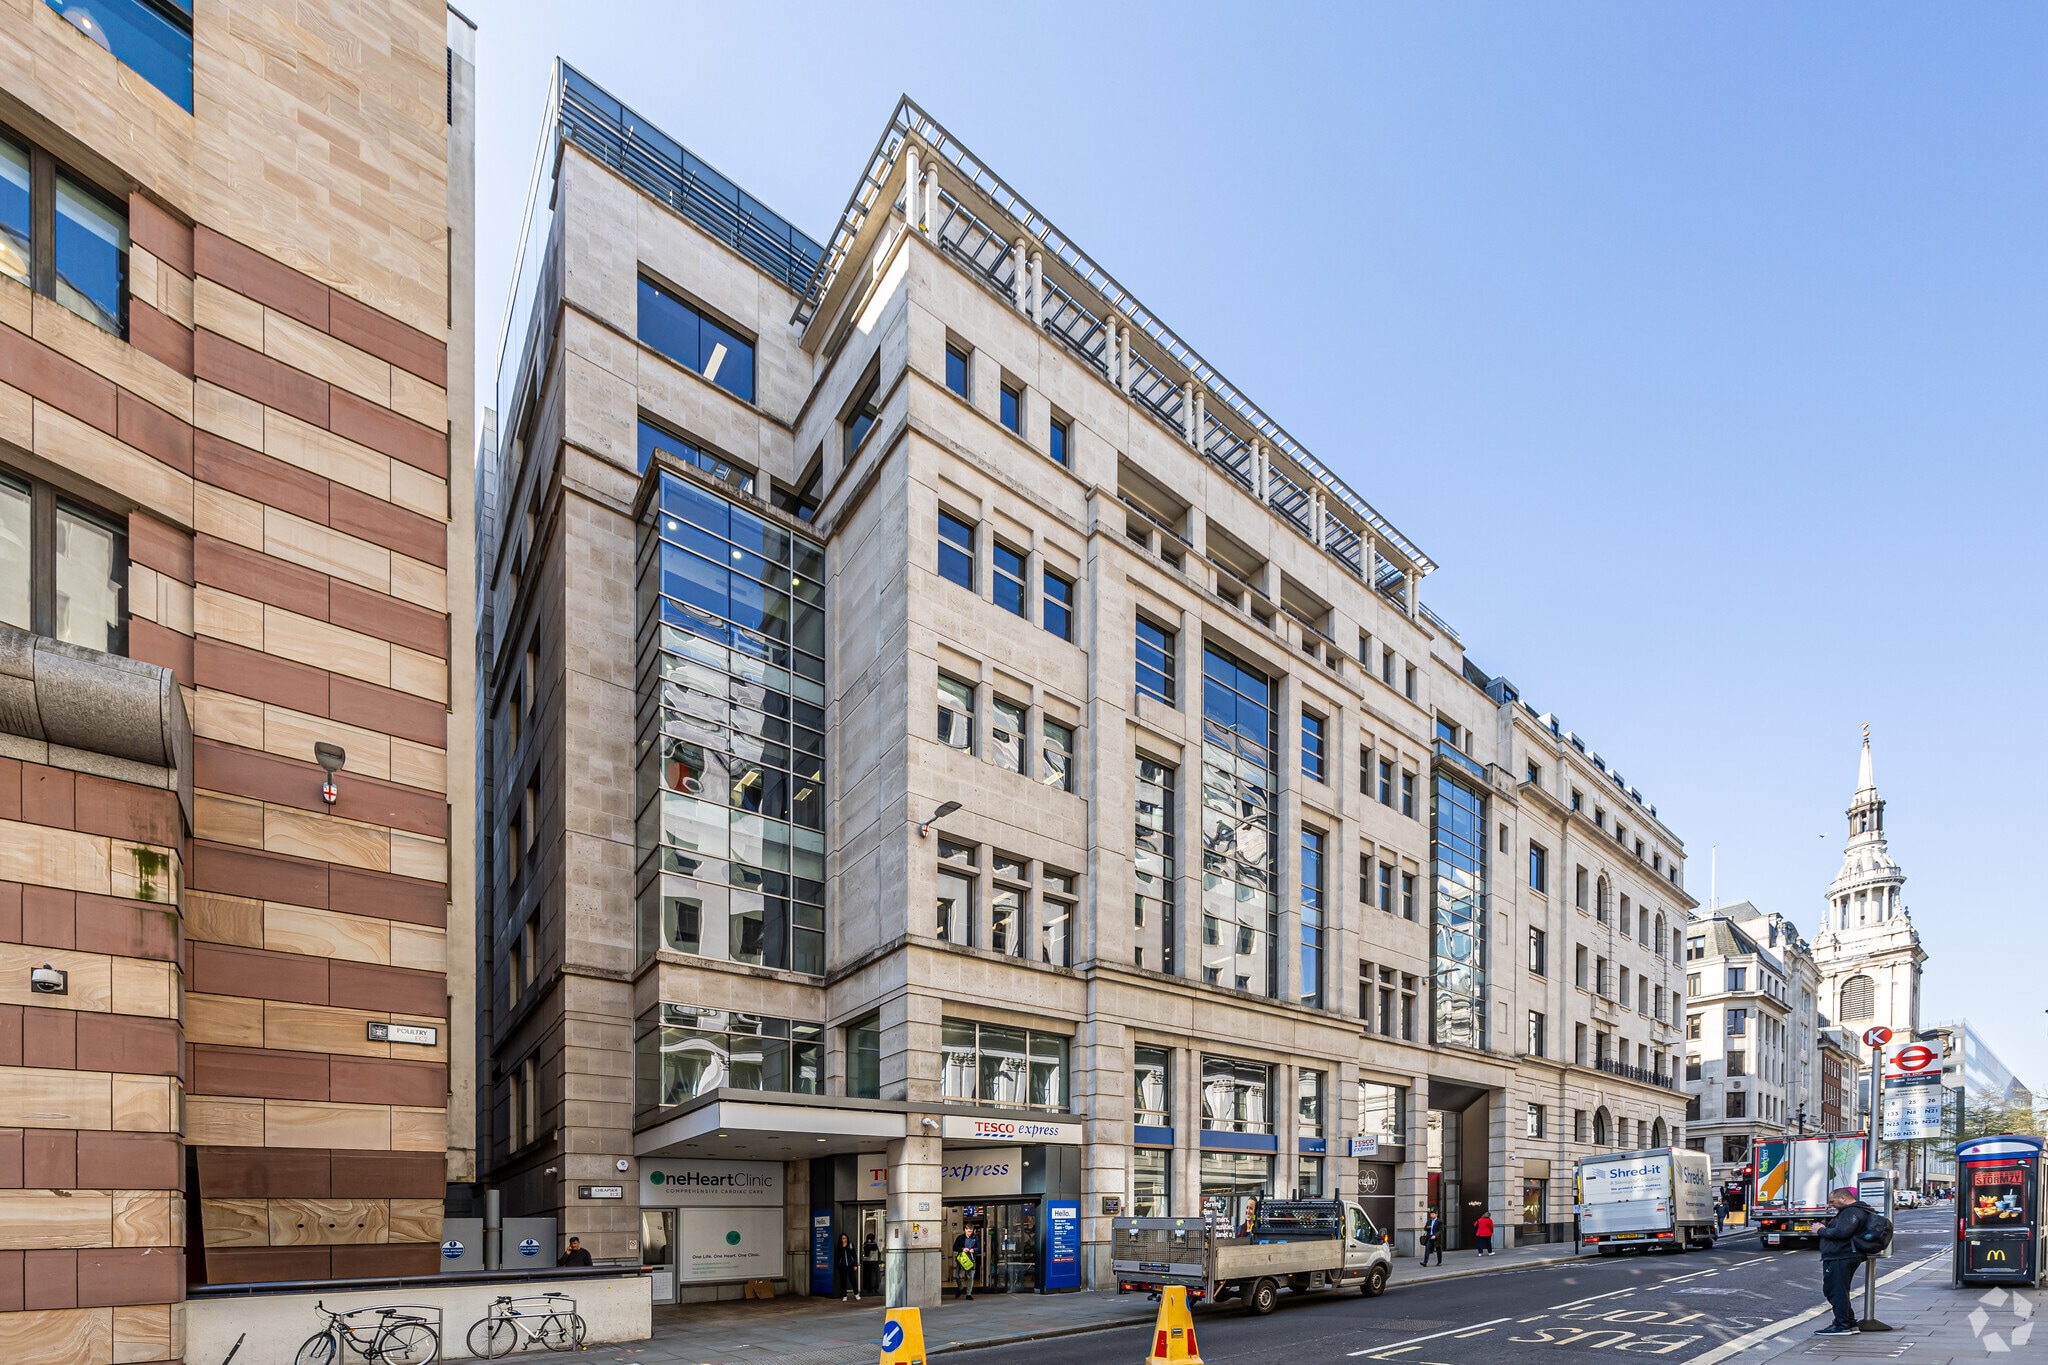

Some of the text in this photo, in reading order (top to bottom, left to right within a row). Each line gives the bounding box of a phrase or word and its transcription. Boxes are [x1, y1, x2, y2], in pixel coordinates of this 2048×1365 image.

[396, 1028, 428, 1036] POULTRY
[1868, 1029, 1886, 1045] K
[974, 1121, 1059, 1137] TESCO express
[941, 1162, 1009, 1182] express
[1609, 1164, 1661, 1179] Shred-it
[1976, 1174, 2020, 1185] STORMZY
[1507, 1327, 1704, 1355] BUS
